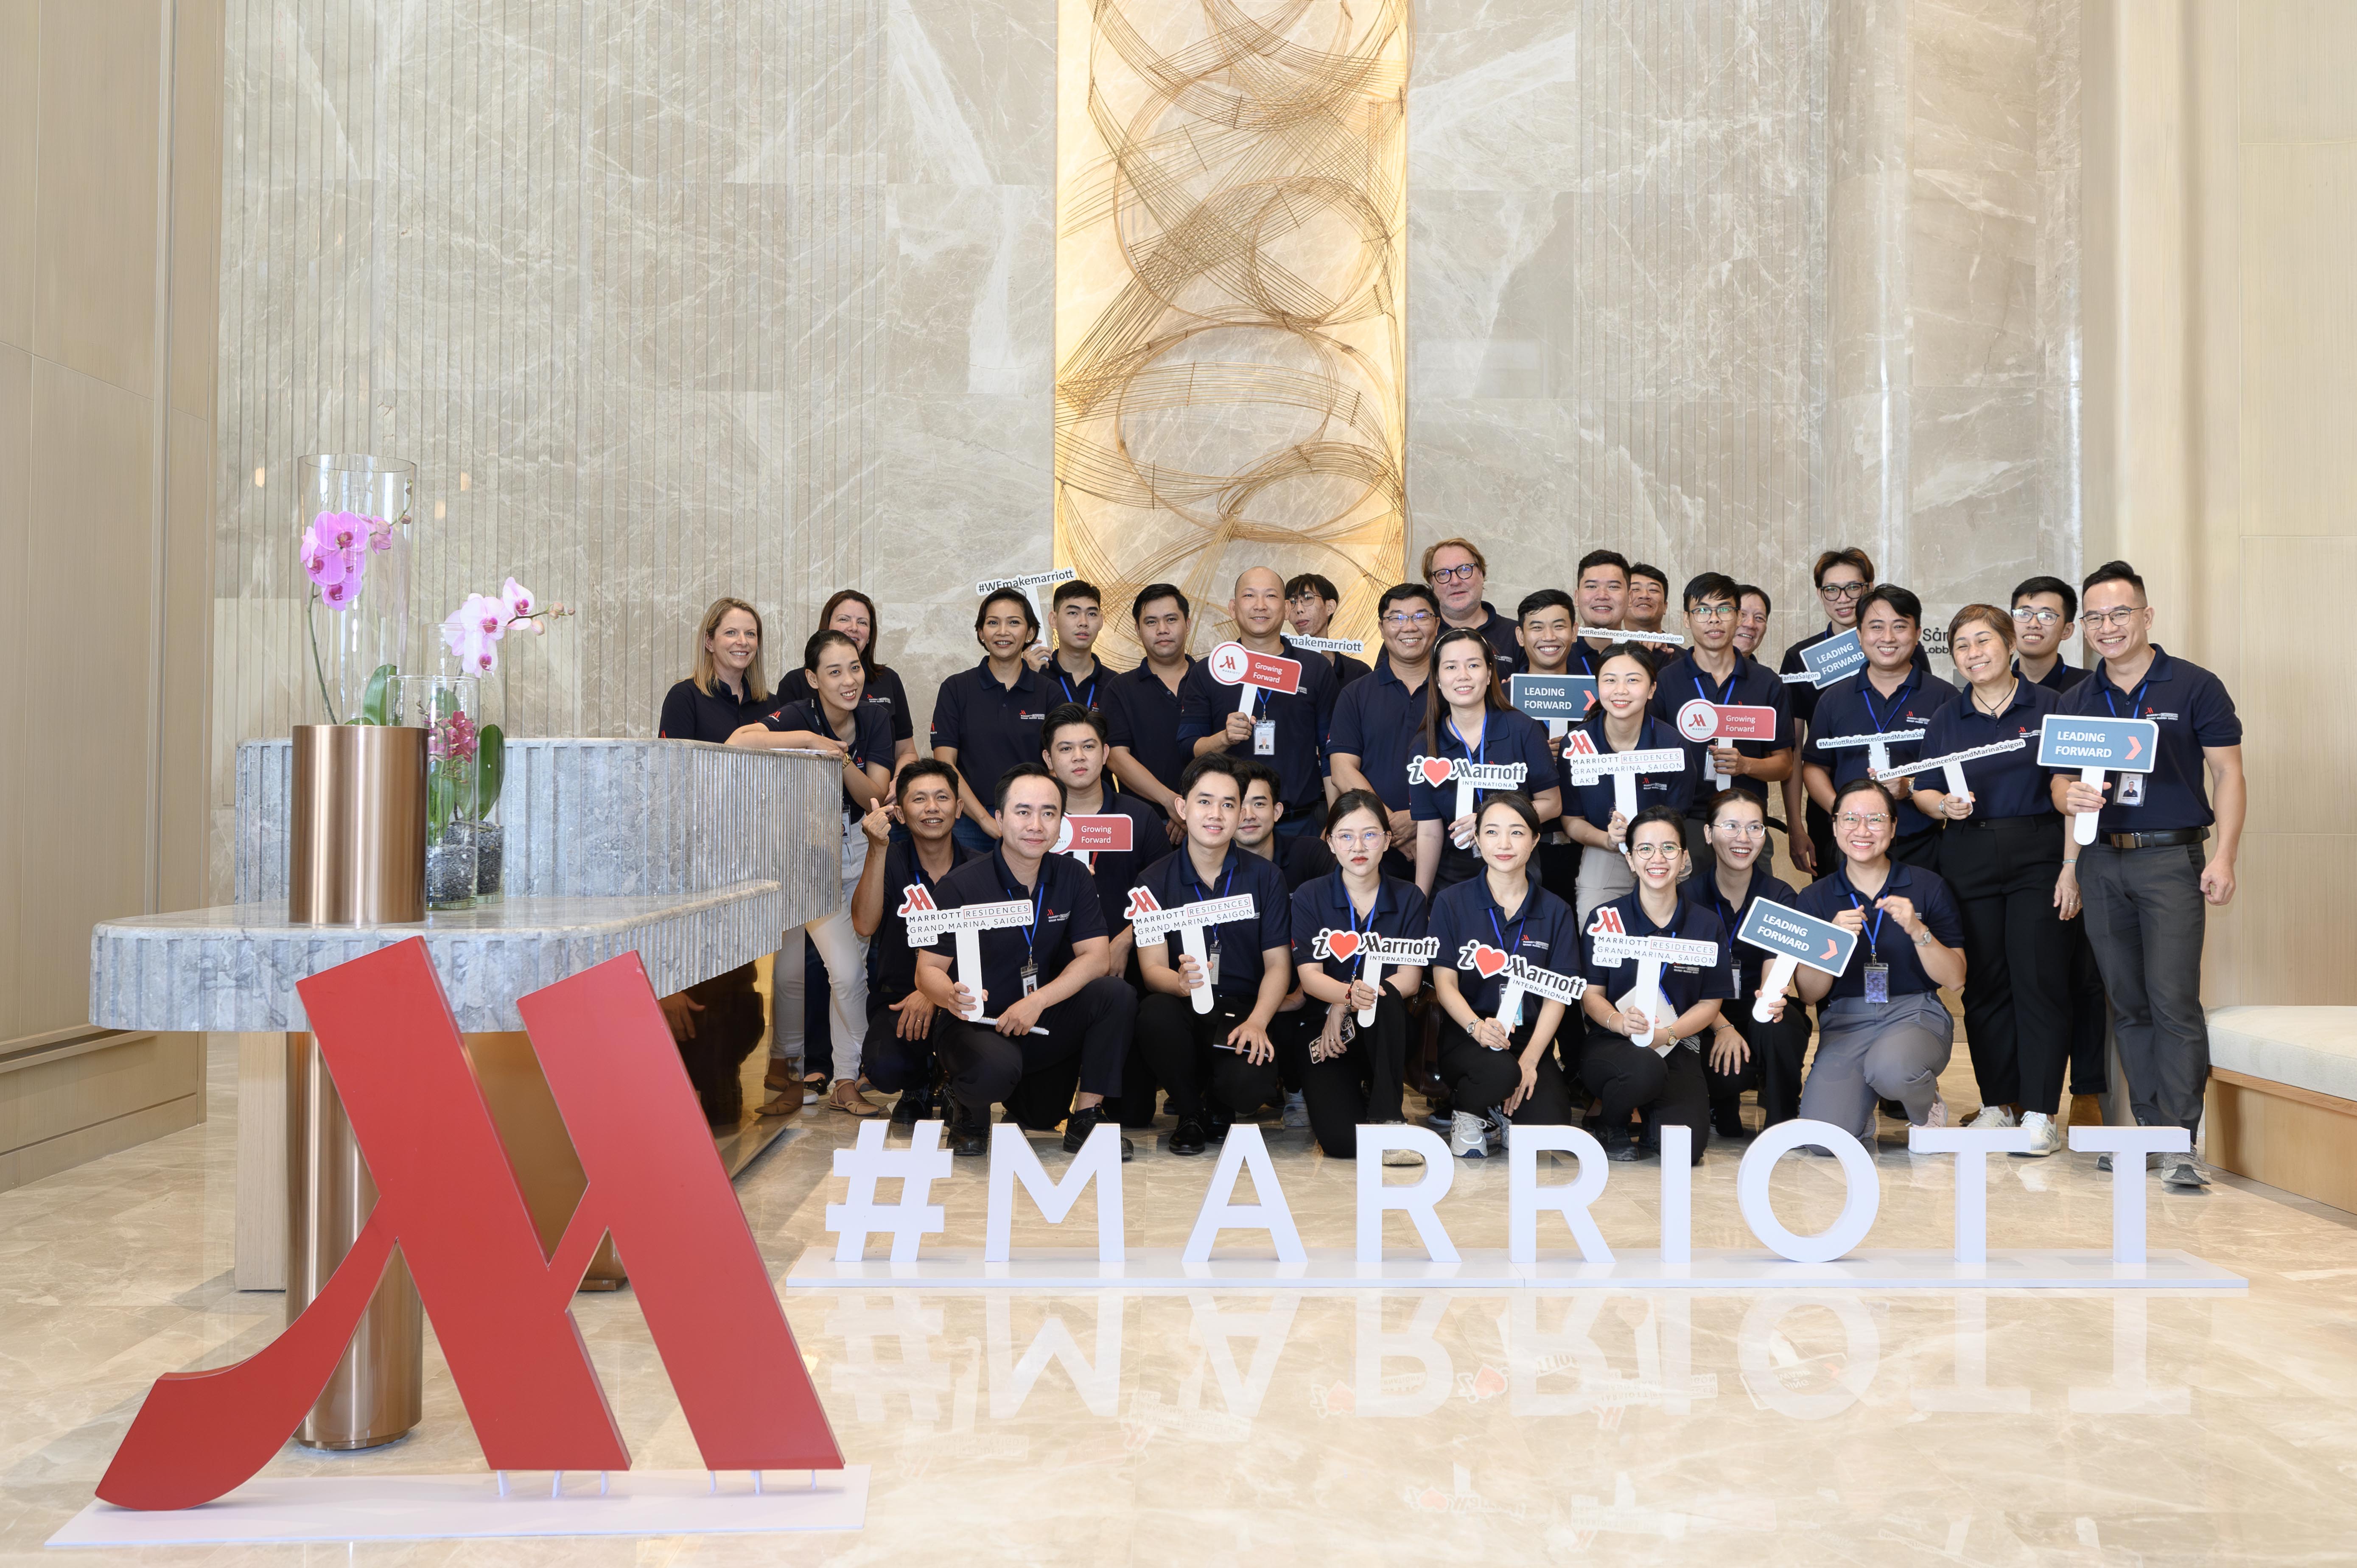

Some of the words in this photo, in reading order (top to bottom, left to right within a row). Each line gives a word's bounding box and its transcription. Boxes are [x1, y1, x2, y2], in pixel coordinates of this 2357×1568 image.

[978, 570, 1074, 593] #WEmakemarriott
[1283, 635, 1362, 651] makemarriott
[1578, 629, 1682, 642] iottResidencesGrandMarinaSaigon
[1817, 643, 1854, 665] LEADING
[1926, 646, 1951, 654] obb
[1255, 662, 1282, 675] Growing
[1822, 651, 1865, 675] FORWARD
[1253, 672, 1280, 683] Forward
[1782, 673, 1819, 681] arinaSaigon
[1524, 687, 1565, 696] LEADING
[1524, 700, 1572, 710] FORWARD
[1726, 715, 1756, 724] Growing
[1819, 731, 1924, 747] #MarriottResidencesGrandMarinaSai
[2057, 731, 2105, 743] LEADING
[1573, 756, 1620, 765] MARRIOTT
[1623, 753, 1680, 762] RESIDENCES
[1879, 740, 2024, 779] #MarriottResidencesGrandMarinaSaigon
[2055, 745, 2112, 758] FORWARD
[1450, 761, 1526, 780] Marriott
[1648, 763, 1682, 771] SAIGON
[1081, 825, 1111, 834] Growing
[909, 911, 961, 923] MARRIOTT
[966, 905, 1029, 917] RESIDENCES
[1136, 910, 1185, 925] MARRIOTT
[1189, 898, 1249, 915] RESIDENCES
[910, 924, 944, 934] GRAND
[948, 920, 990, 930] MARINA,
[994, 915, 1032, 925] SAIGON
[1138, 924, 1170, 935] GRAND
[1174, 917, 1213, 928] MARINA,
[1217, 908, 1253, 920] SAIGON
[1763, 914, 1808, 938] LEADING
[911, 936, 935, 944] LAKE
[1139, 935, 1163, 945] LAKE
[1358, 934, 1437, 955] Marriott
[1598, 936, 1649, 946] MARRIOTT
[1653, 941, 1715, 954] RESIDENCES
[1757, 925, 1810, 952] FORWARD
[1369, 956, 1426, 964] INTERNATIONAL
[1596, 956, 1620, 964] LAKE
[1597, 946, 1630, 955] GRAND
[1634, 950, 1674, 961] MARINA,
[1678, 954, 1715, 964] SAIGON
[1502, 958, 1584, 996] Marriott
[1513, 979, 1569, 1002] INTERNATIONAL
[825, 1119, 2191, 1263] #MARRIOTT
